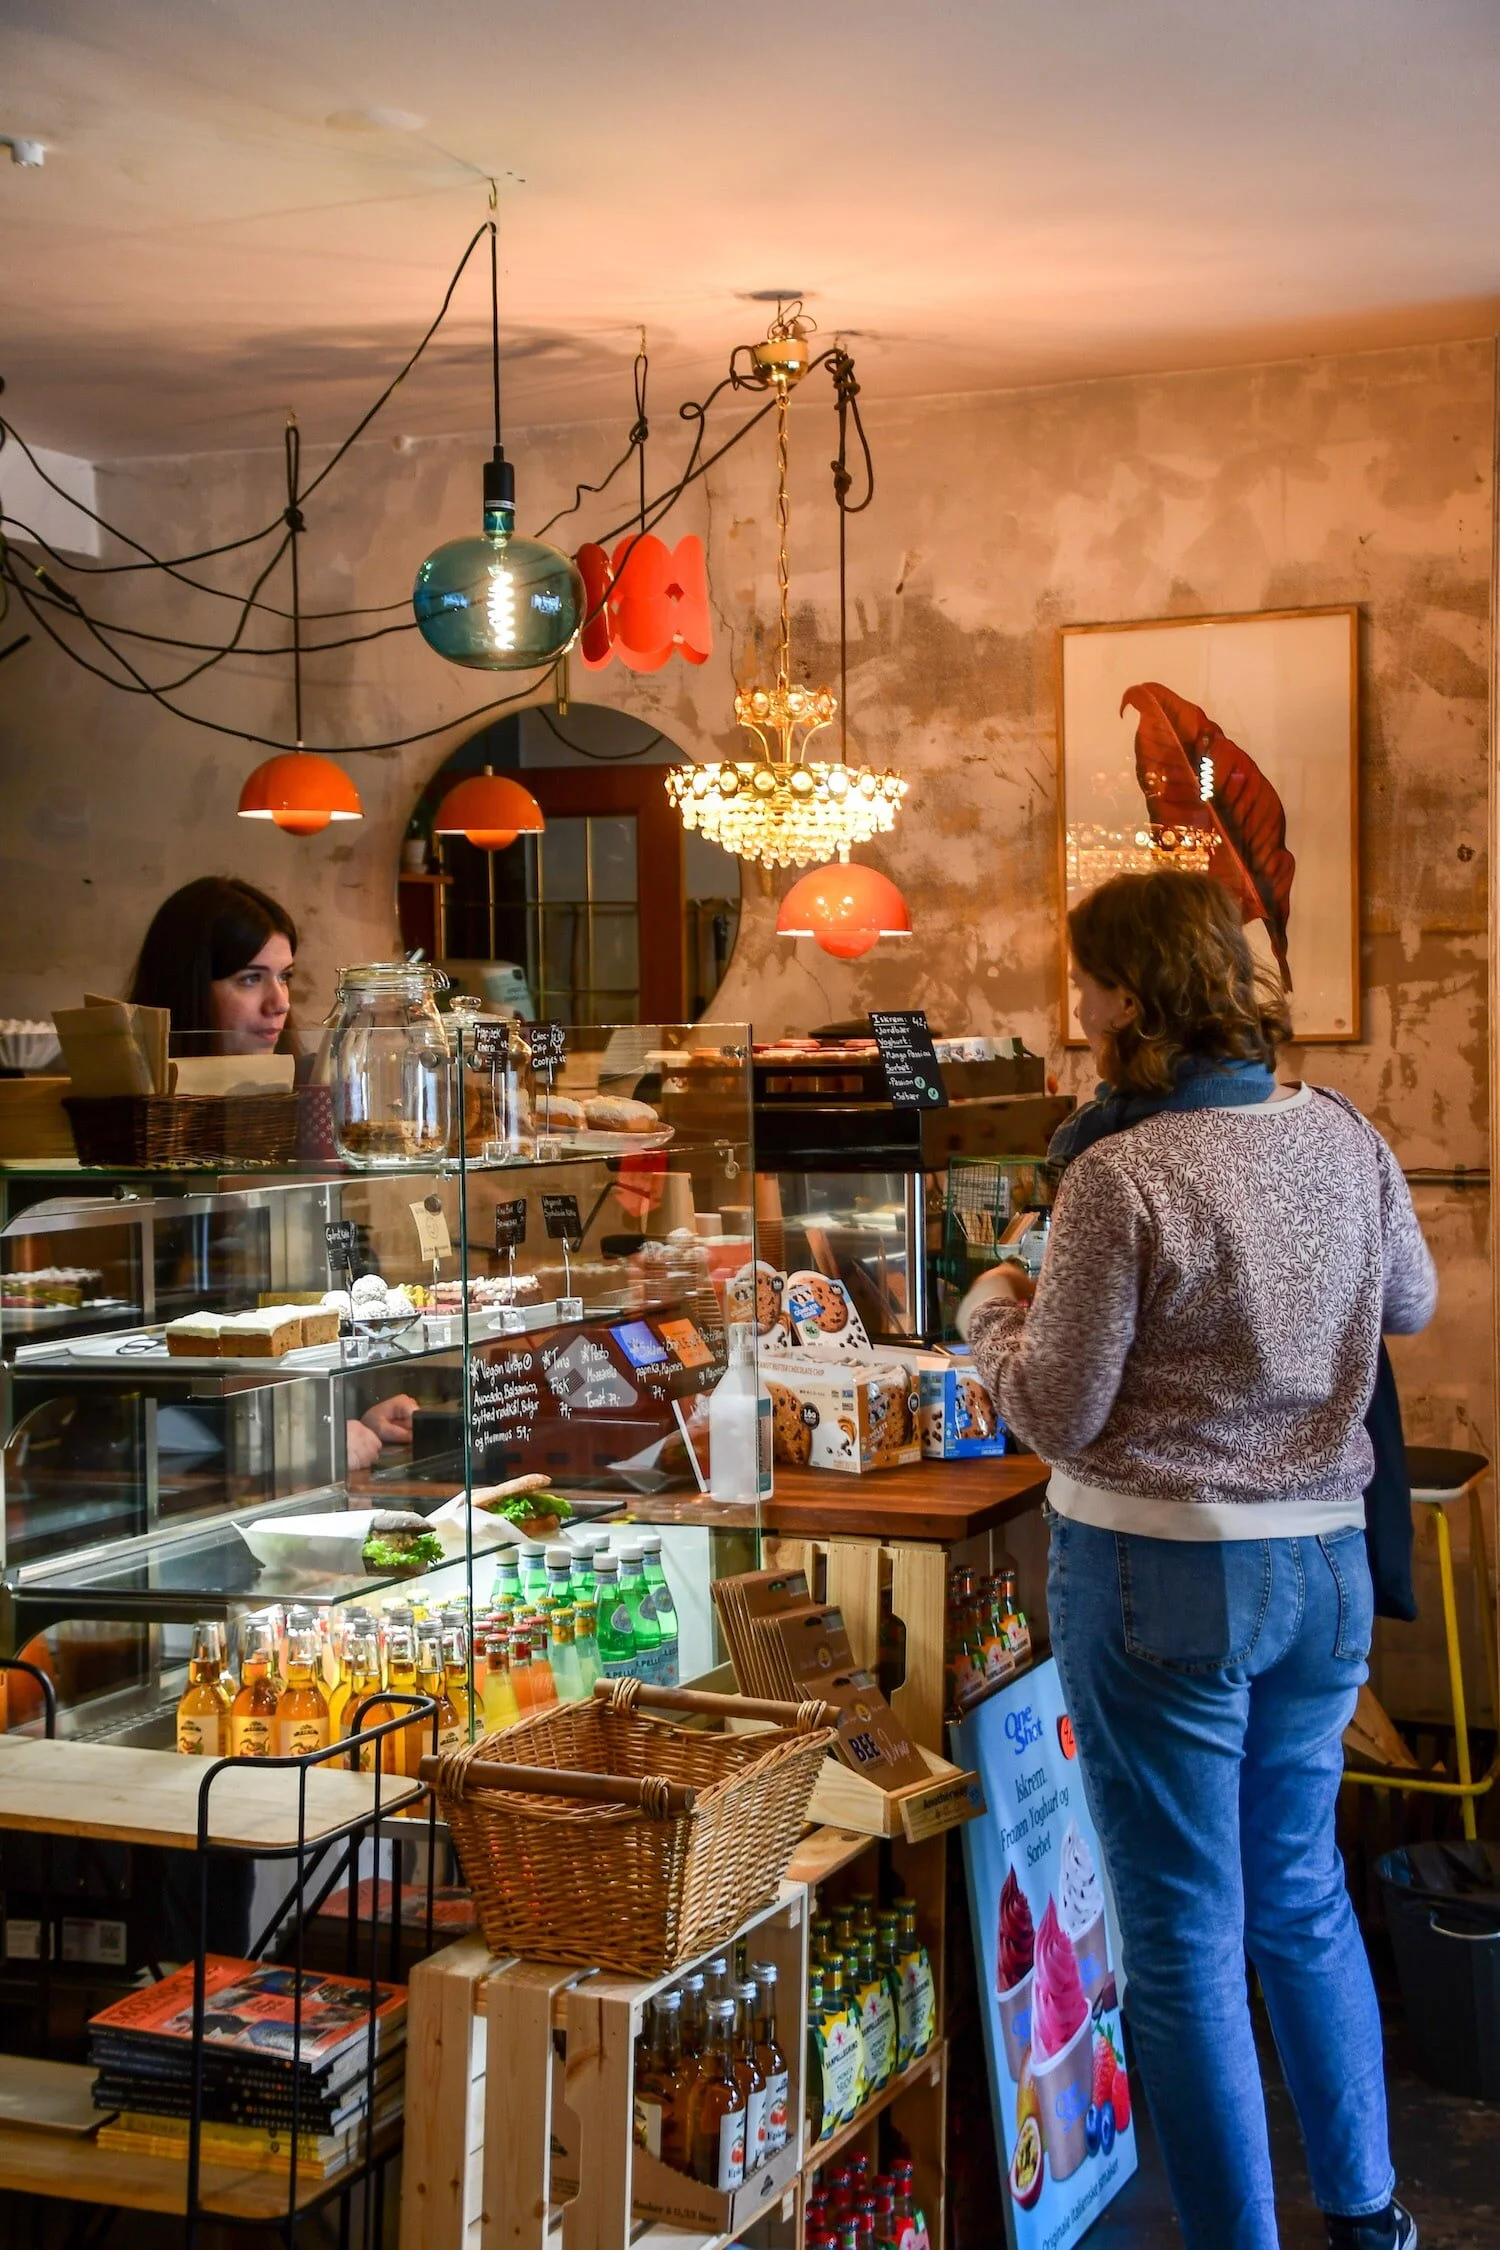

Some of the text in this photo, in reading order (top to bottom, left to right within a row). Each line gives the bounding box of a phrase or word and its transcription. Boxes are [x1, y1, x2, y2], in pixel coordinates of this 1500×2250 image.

[480, 1358, 504, 1386] Vegan
[475, 1436, 484, 1453] og
[1004, 1706, 1032, 1740] One
[1014, 1716, 1043, 1755] Shot
[848, 1732, 881, 1762] BEE
[1000, 1786, 1069, 1852] Frozen Yoghurt og
[1026, 1830, 1052, 1867] Sorbet
[825, 2040, 858, 2070] SANPELLEGRINO
